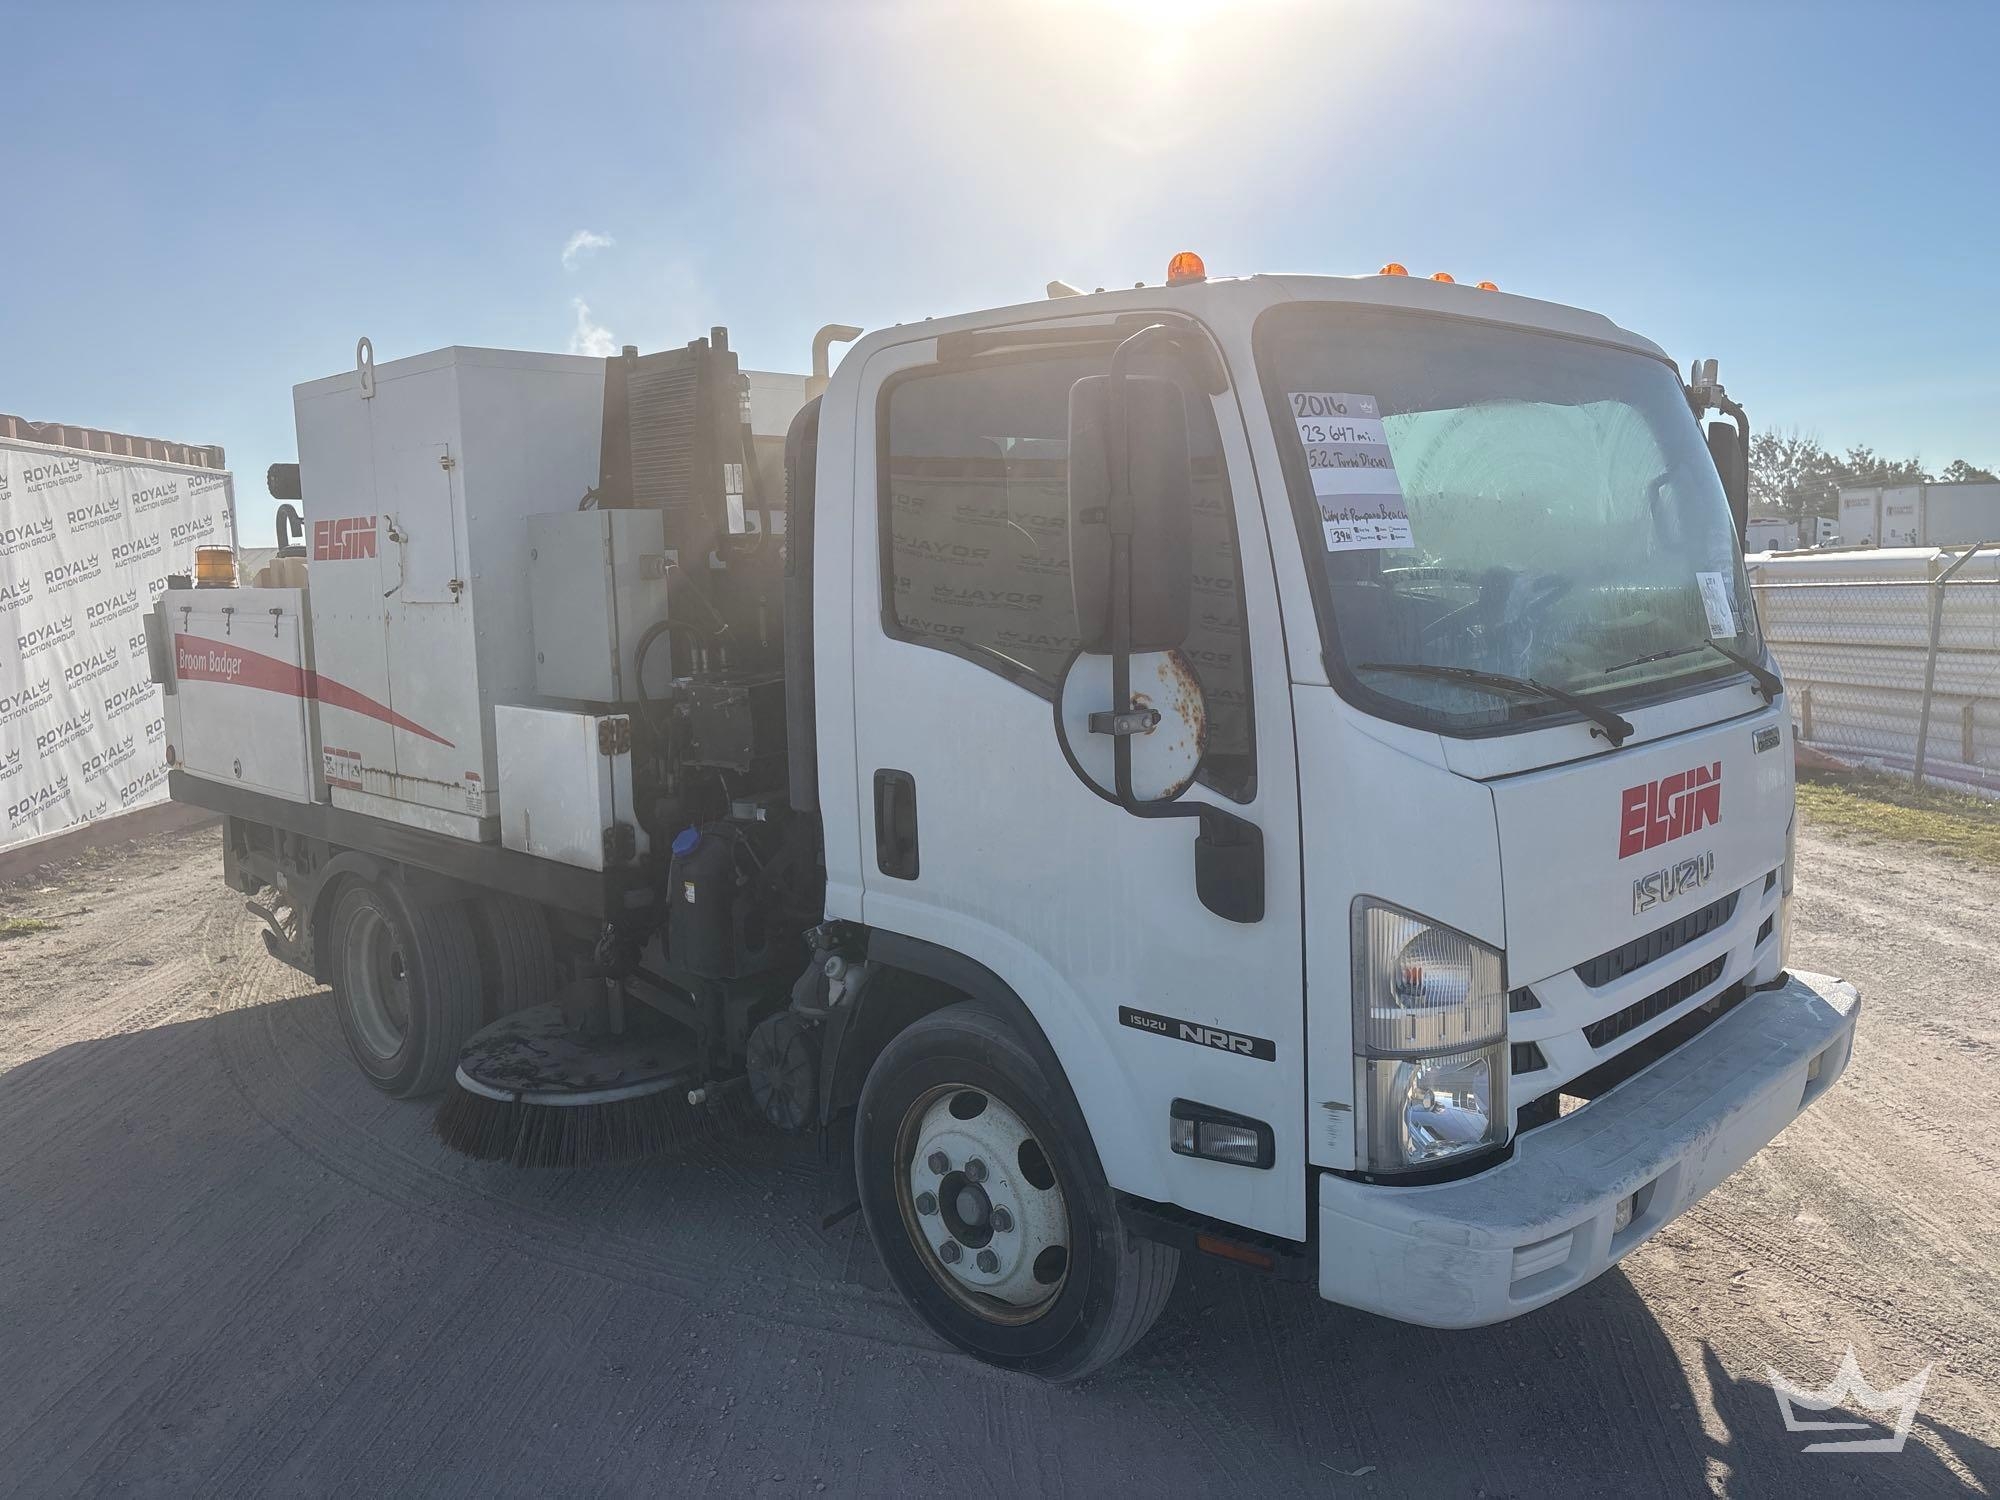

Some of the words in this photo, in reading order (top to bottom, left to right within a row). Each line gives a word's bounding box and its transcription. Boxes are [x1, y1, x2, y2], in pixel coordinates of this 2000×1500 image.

[1294, 393, 1348, 418] 2016
[22, 461, 70, 484] ROYAL
[1358, 452, 1388, 469] Diesel
[27, 481, 58, 494] AUCTION
[58, 473, 83, 486] GROUP
[131, 484, 169, 505] ROYAL
[66, 501, 110, 525] ROYAL
[135, 501, 160, 514] AUCTION
[160, 494, 180, 507] GROUP
[70, 520, 100, 534] AUCTION
[99, 511, 122, 525] GROUP
[170, 518, 205, 539] ROYAL
[31, 532, 57, 547] GROUP
[111, 536, 151, 560] ROYAL
[173, 533, 197, 547] AUCTION
[196, 527, 215, 539] GROUP
[313, 515, 378, 561] ELGIN
[114, 552, 141, 569] AUCTION
[142, 546, 162, 560] GROUP
[44, 559, 89, 585] ROYAL
[48, 576, 78, 594] AUCTION
[78, 568, 102, 583] GROUP
[7, 594, 34, 611] GROUP
[86, 593, 128, 620] ROYAL
[89, 611, 118, 629] AUCTION
[118, 602, 140, 616] GROUP
[17, 621, 63, 651] ROYAL
[21, 641, 52, 660] AUCTION
[51, 630, 76, 646] GROUP
[64, 652, 107, 682] ROYAL
[68, 671, 97, 691] AUCTION
[97, 660, 120, 676] GROUP
[179, 648, 207, 671] Broom
[208, 650, 241, 681] Badger
[0, 685, 40, 714] OYAL
[0, 707, 28, 726] UCTION
[28, 692, 53, 712] GROUP
[104, 682, 144, 712] ROYAL
[107, 701, 135, 721] AUCTION
[134, 689, 156, 706] GROUP
[36, 717, 82, 750] ROYAL
[39, 738, 70, 760] AUCTION
[69, 723, 94, 742] GROUP
[0, 763, 23, 782] ROUP
[81, 743, 125, 775] ROYAL
[84, 762, 115, 785] AUCTION
[113, 748, 137, 767] GROUP
[120, 767, 160, 801] ROYAL
[122, 785, 150, 809] AUCTION
[7, 784, 58, 821] ROYAL
[11, 804, 45, 830] AUCTION
[45, 788, 72, 809] GROUP
[1618, 760, 1722, 860] ELGIN
[1632, 850, 1715, 916] ISUZU
[1130, 1013, 1167, 1032] ISUZU
[1179, 1023, 1255, 1055] NRR
